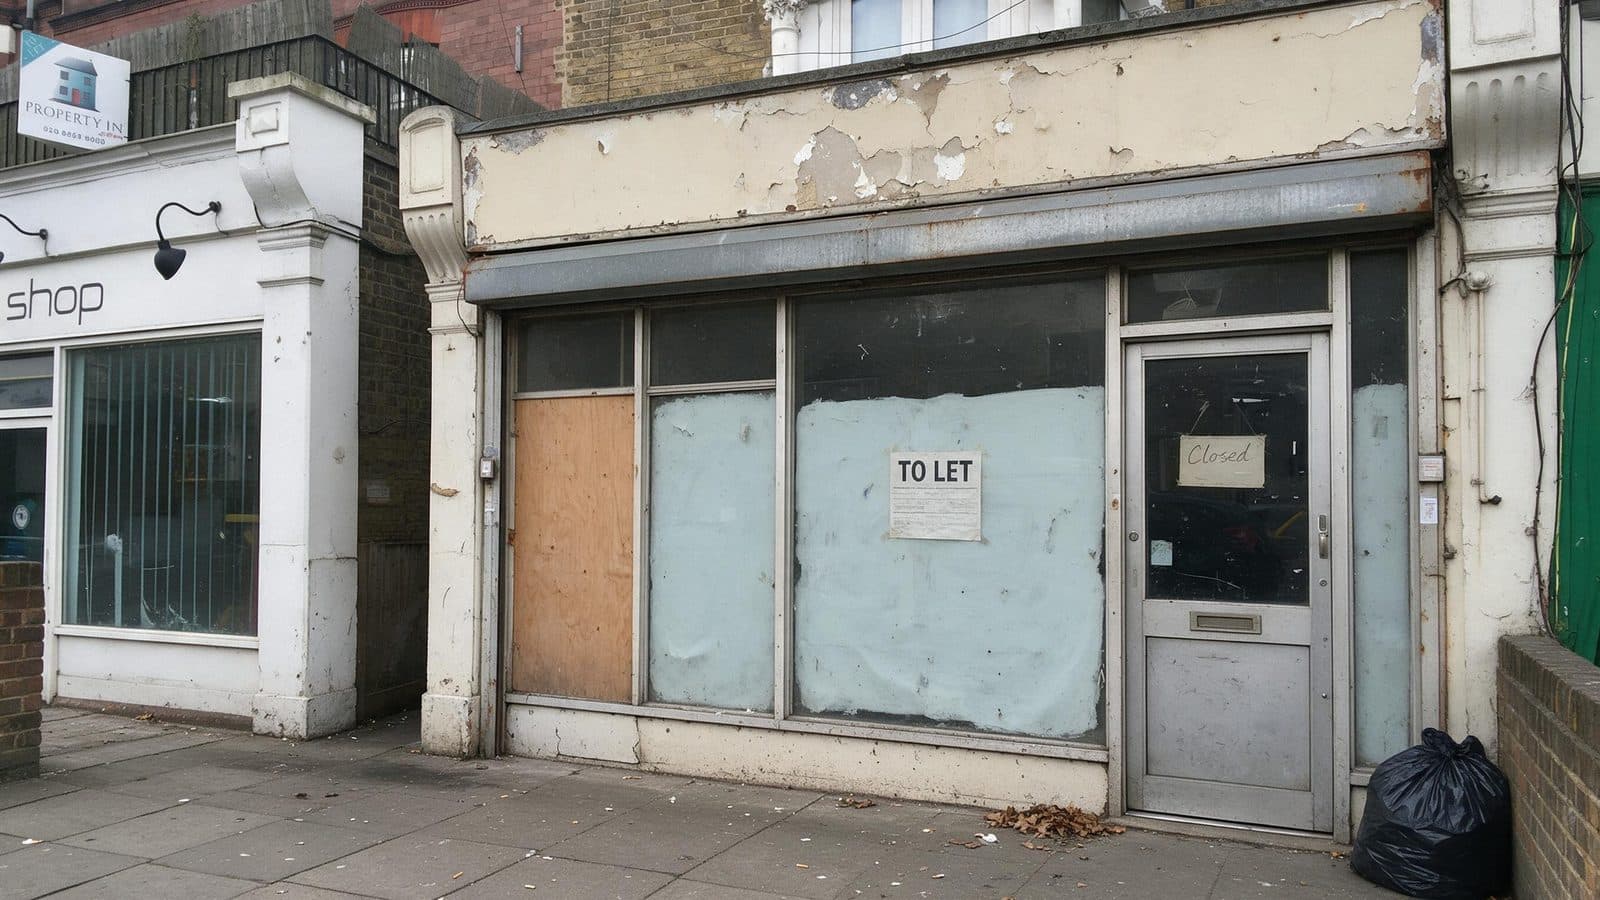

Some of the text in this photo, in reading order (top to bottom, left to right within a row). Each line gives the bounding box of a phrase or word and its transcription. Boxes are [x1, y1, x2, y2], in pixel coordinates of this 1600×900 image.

[25, 101, 123, 133] PROPERTY IN
[7, 278, 104, 325] shop
[1188, 443, 1250, 465] Closed
[898, 460, 973, 482] TO LET
